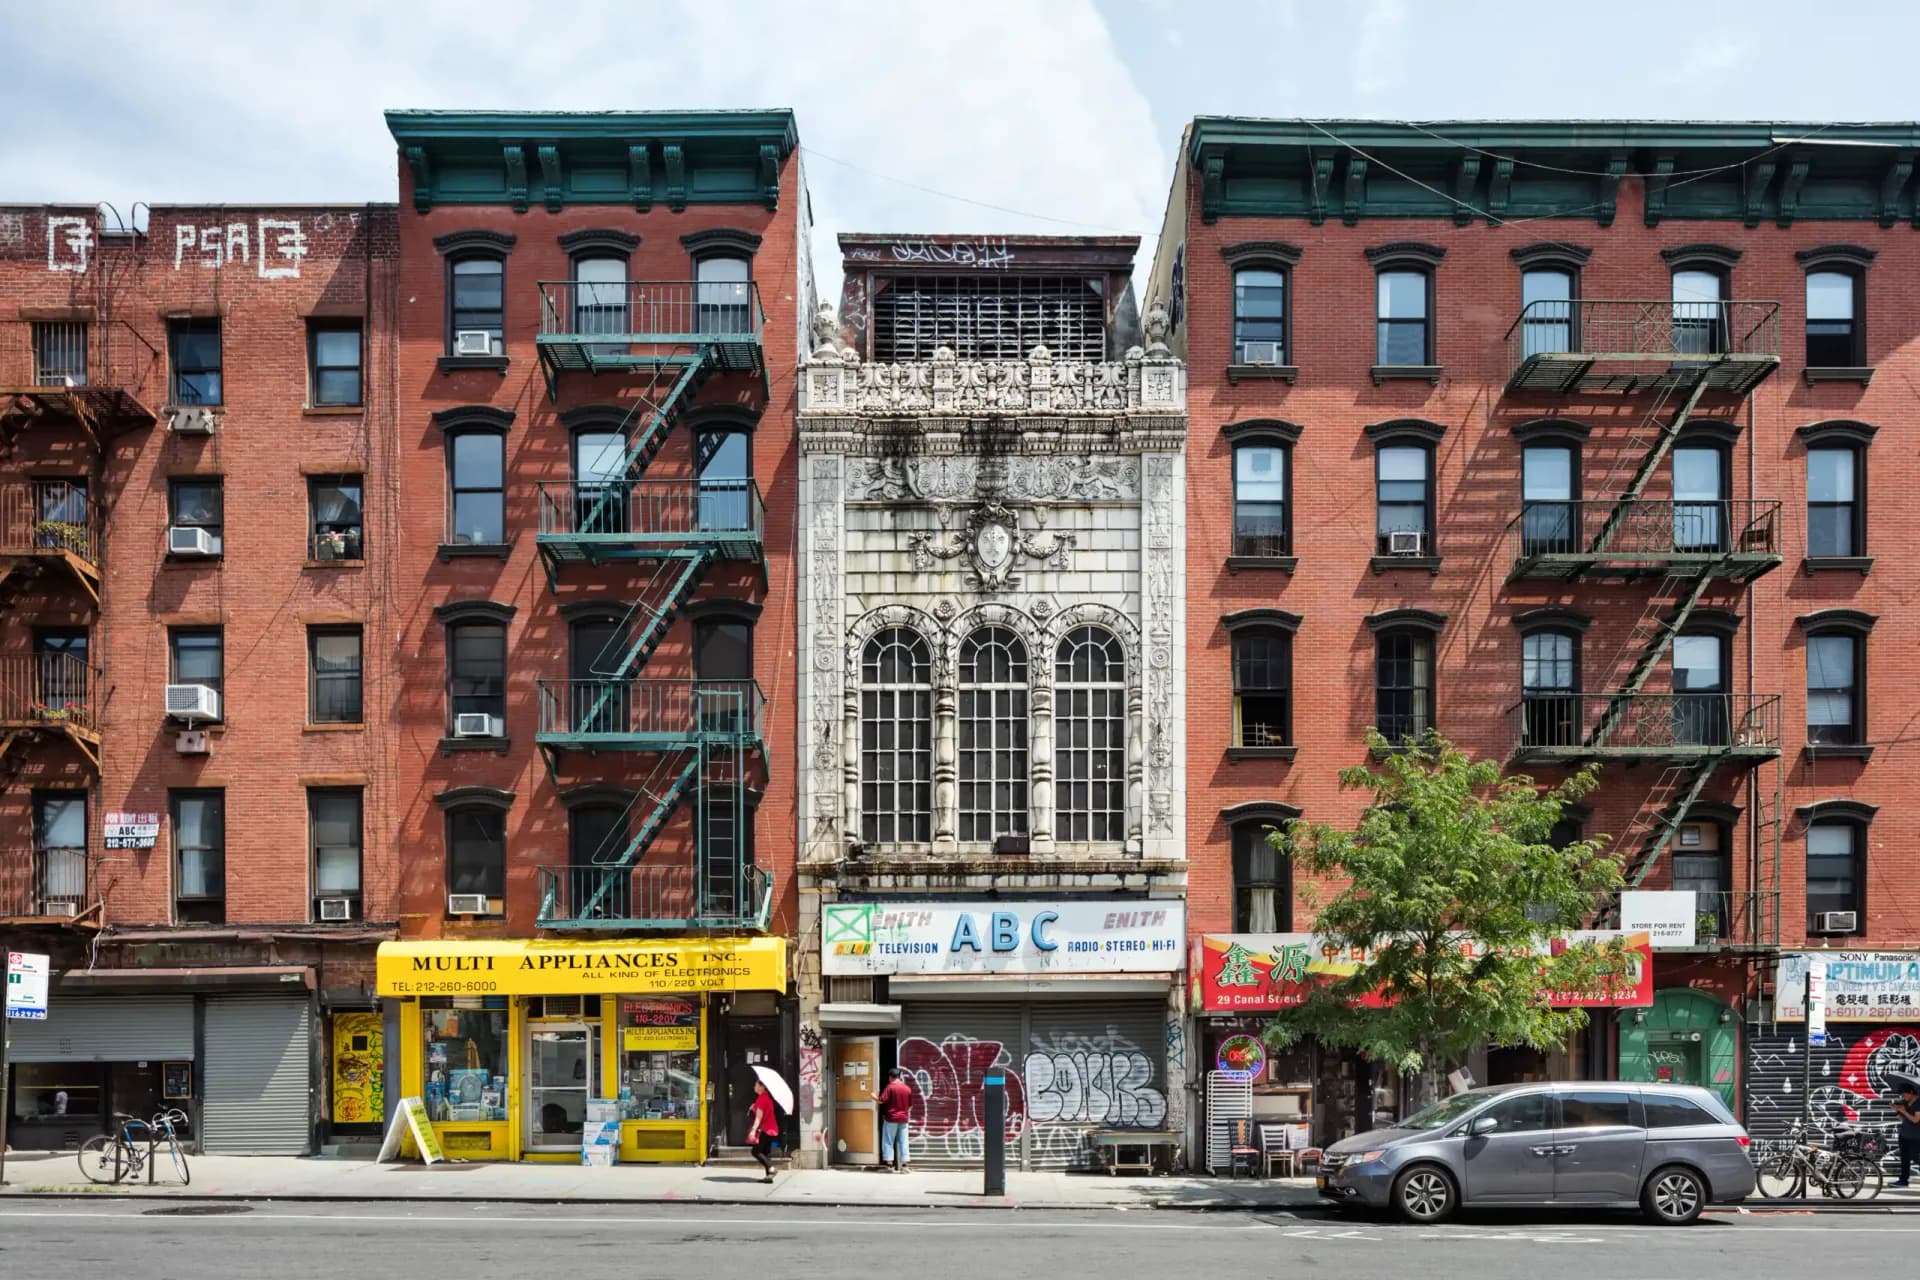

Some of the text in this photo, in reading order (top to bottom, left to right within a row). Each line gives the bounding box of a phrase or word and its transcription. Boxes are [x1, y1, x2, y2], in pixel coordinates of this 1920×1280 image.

[105, 813, 118, 823] FOR
[119, 826, 135, 835] ABC
[1103, 911, 1166, 929] ENITH
[950, 911, 1059, 952] ABC
[879, 943, 938, 954] TELEVISION
[1068, 942, 1098, 952] RADIO
[1106, 941, 1145, 951] STEREO
[413, 952, 742, 971] MULTI APPLIANCES INC.
[1840, 953, 1868, 961] SONY
[1214, 942, 1312, 987] 鑫源
[664, 968, 750, 977] ELECTRONICS
[650, 980, 695, 988] 110/220
[1217, 995, 1230, 1004] 29
[1234, 995, 1264, 1004] Canal
[624, 1001, 693, 1014] ELECTRONICS
